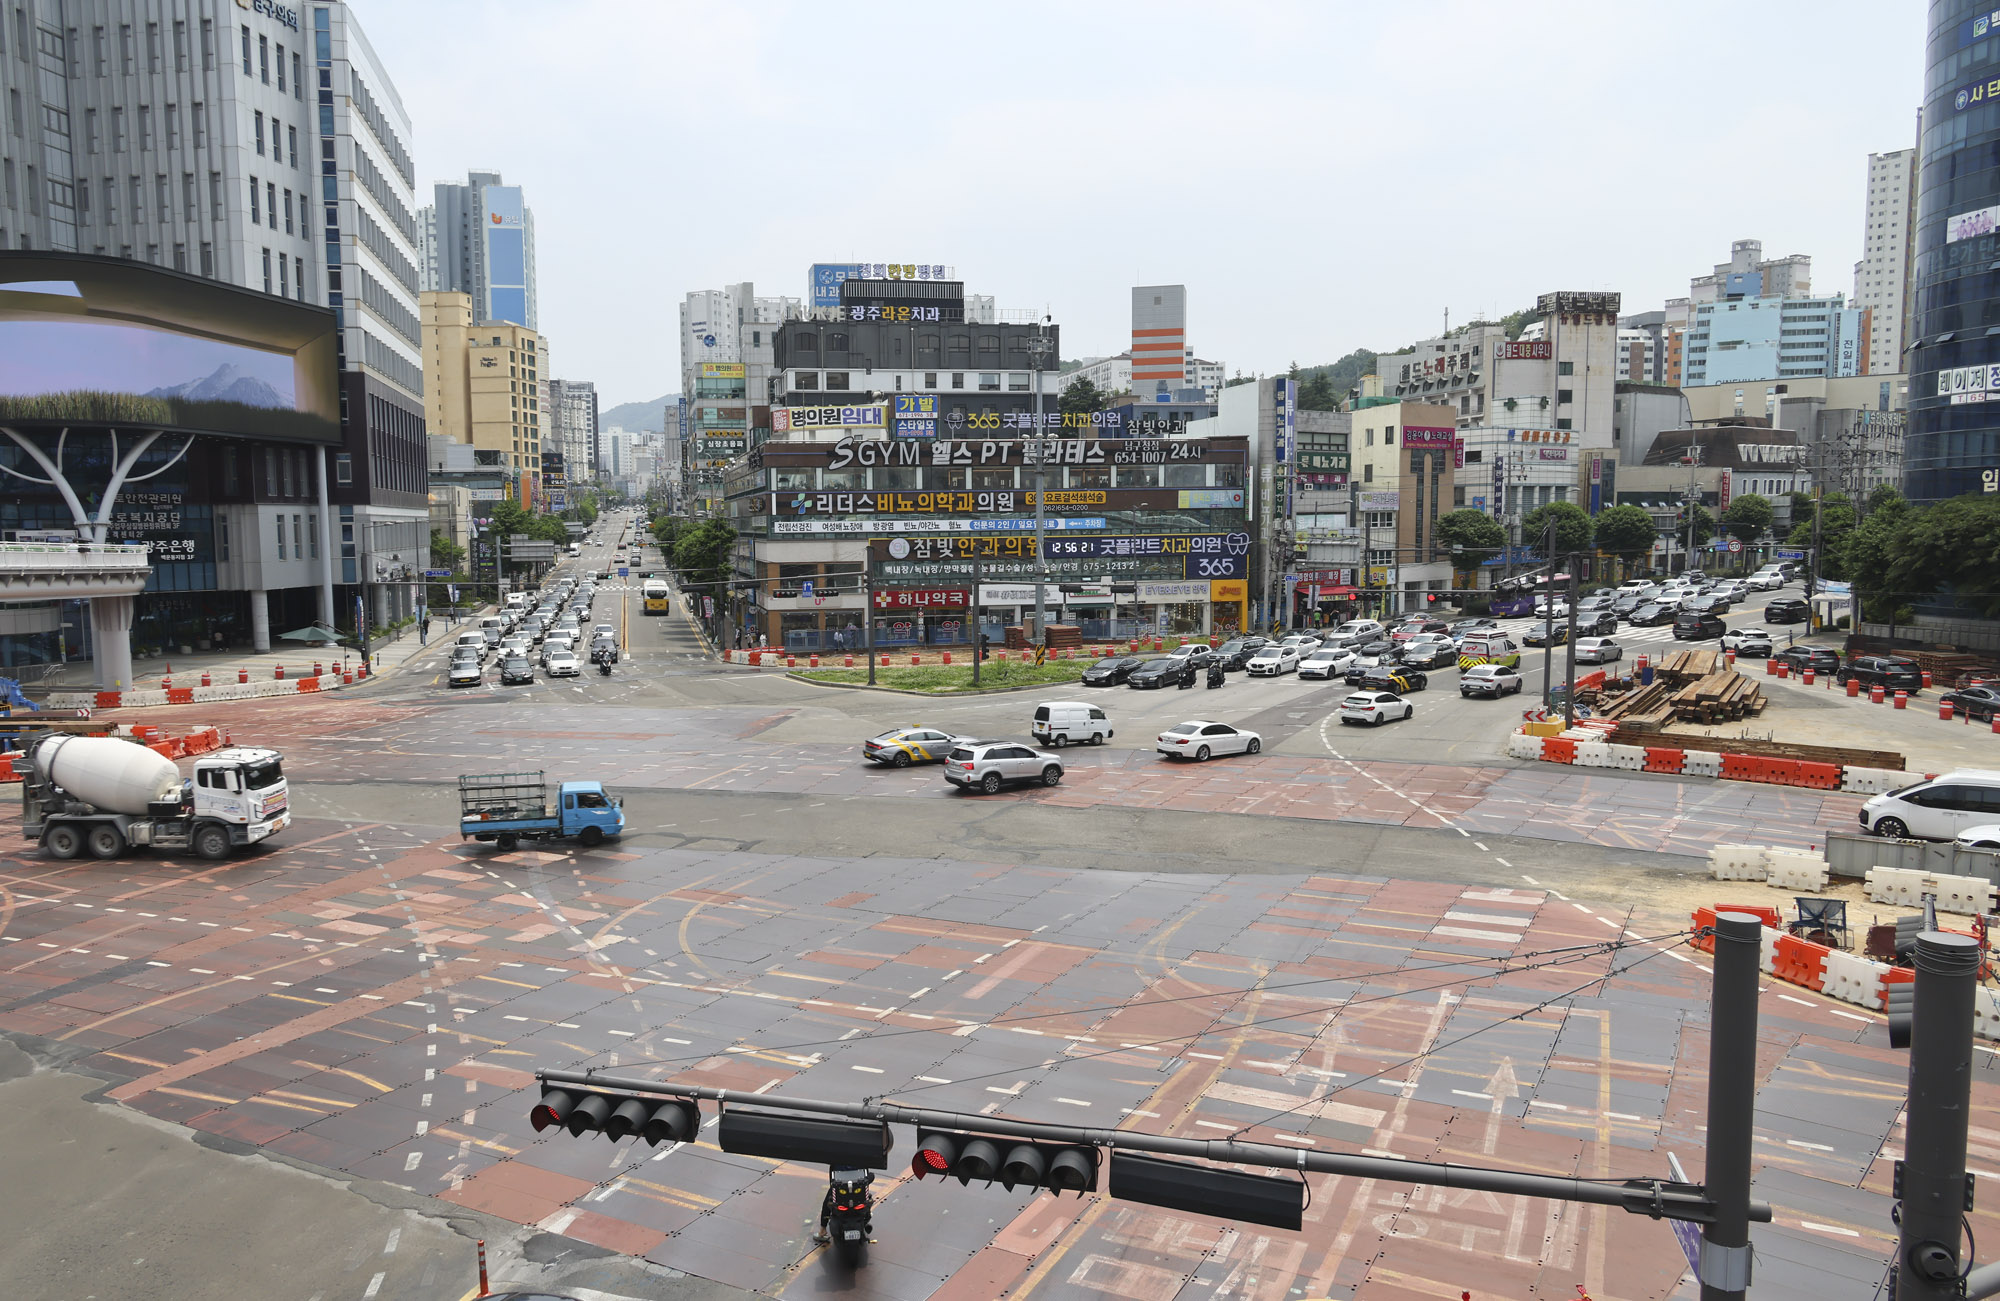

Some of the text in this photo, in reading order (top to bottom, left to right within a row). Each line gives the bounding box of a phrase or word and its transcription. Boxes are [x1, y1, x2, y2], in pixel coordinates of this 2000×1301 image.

[858, 263, 946, 280] 경희한방병원
[815, 285, 841, 298] 내과
[850, 305, 941, 322] 광주라온치과
[899, 397, 934, 412] 가발
[791, 407, 883, 428] 병의원임대
[967, 412, 1121, 429] 365 굿플란트치과의원
[1126, 420, 1187, 435] 참빛안과
[931, 440, 972, 465] 헬스
[981, 441, 1014, 464] PT
[1114, 451, 1167, 464] 654-1007
[114, 493, 183, 505] 토안전관리원
[816, 490, 1015, 514] 리더스비뇨의학과의원
[108, 511, 181, 523] 로복지공단
[777, 522, 813, 532] 전립선검진
[872, 521, 895, 531] 방광염
[972, 520, 996, 529] 전문의
[141, 539, 196, 554] 광주은행
[1100, 537, 1221, 554] 굿플란트치과의원
[1198, 558, 1234, 576] 365
[1145, 584, 1191, 595] EYE&EYE
[898, 591, 964, 606] 하나약국
